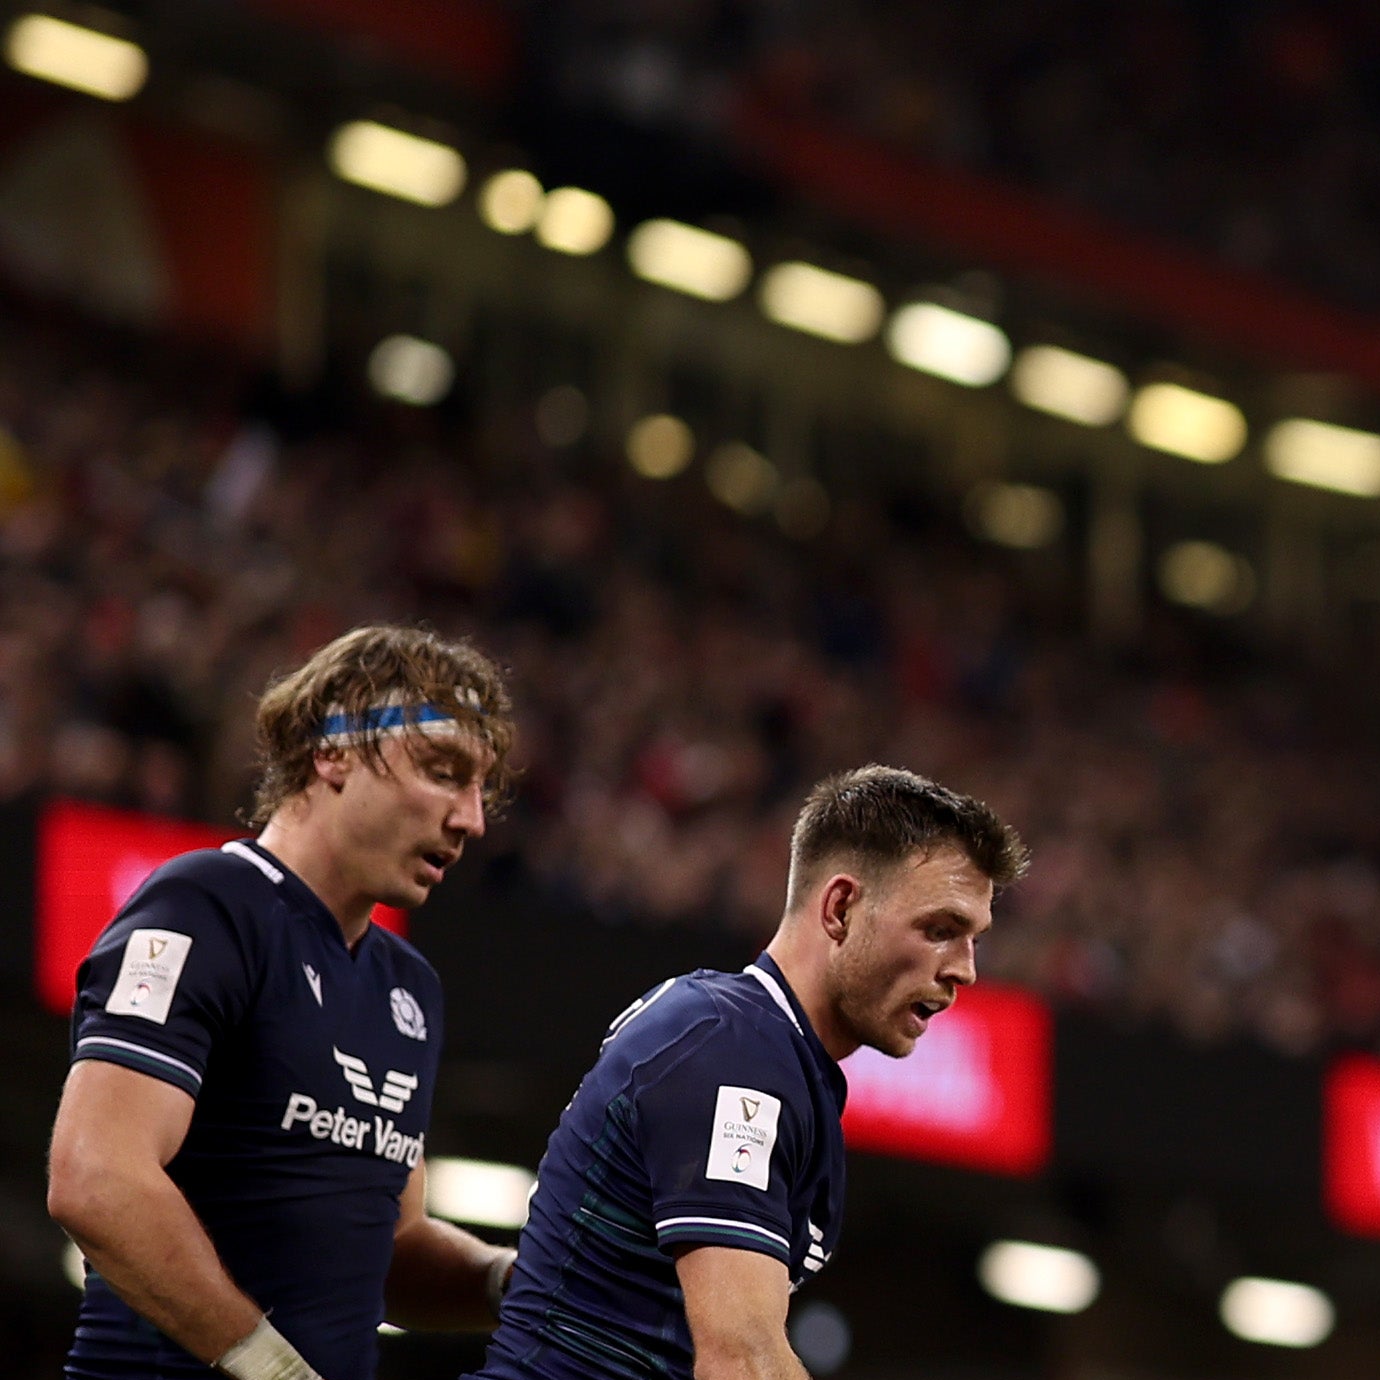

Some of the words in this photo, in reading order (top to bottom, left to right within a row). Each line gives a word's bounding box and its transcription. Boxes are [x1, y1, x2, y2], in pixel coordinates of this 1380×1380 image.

[280, 1092, 371, 1150] Peter
[374, 1115, 425, 1170] Vard
[723, 1121, 768, 1138] GUINNESS
[723, 1131, 735, 1139] SIX
[735, 1133, 765, 1147] NATIONS
